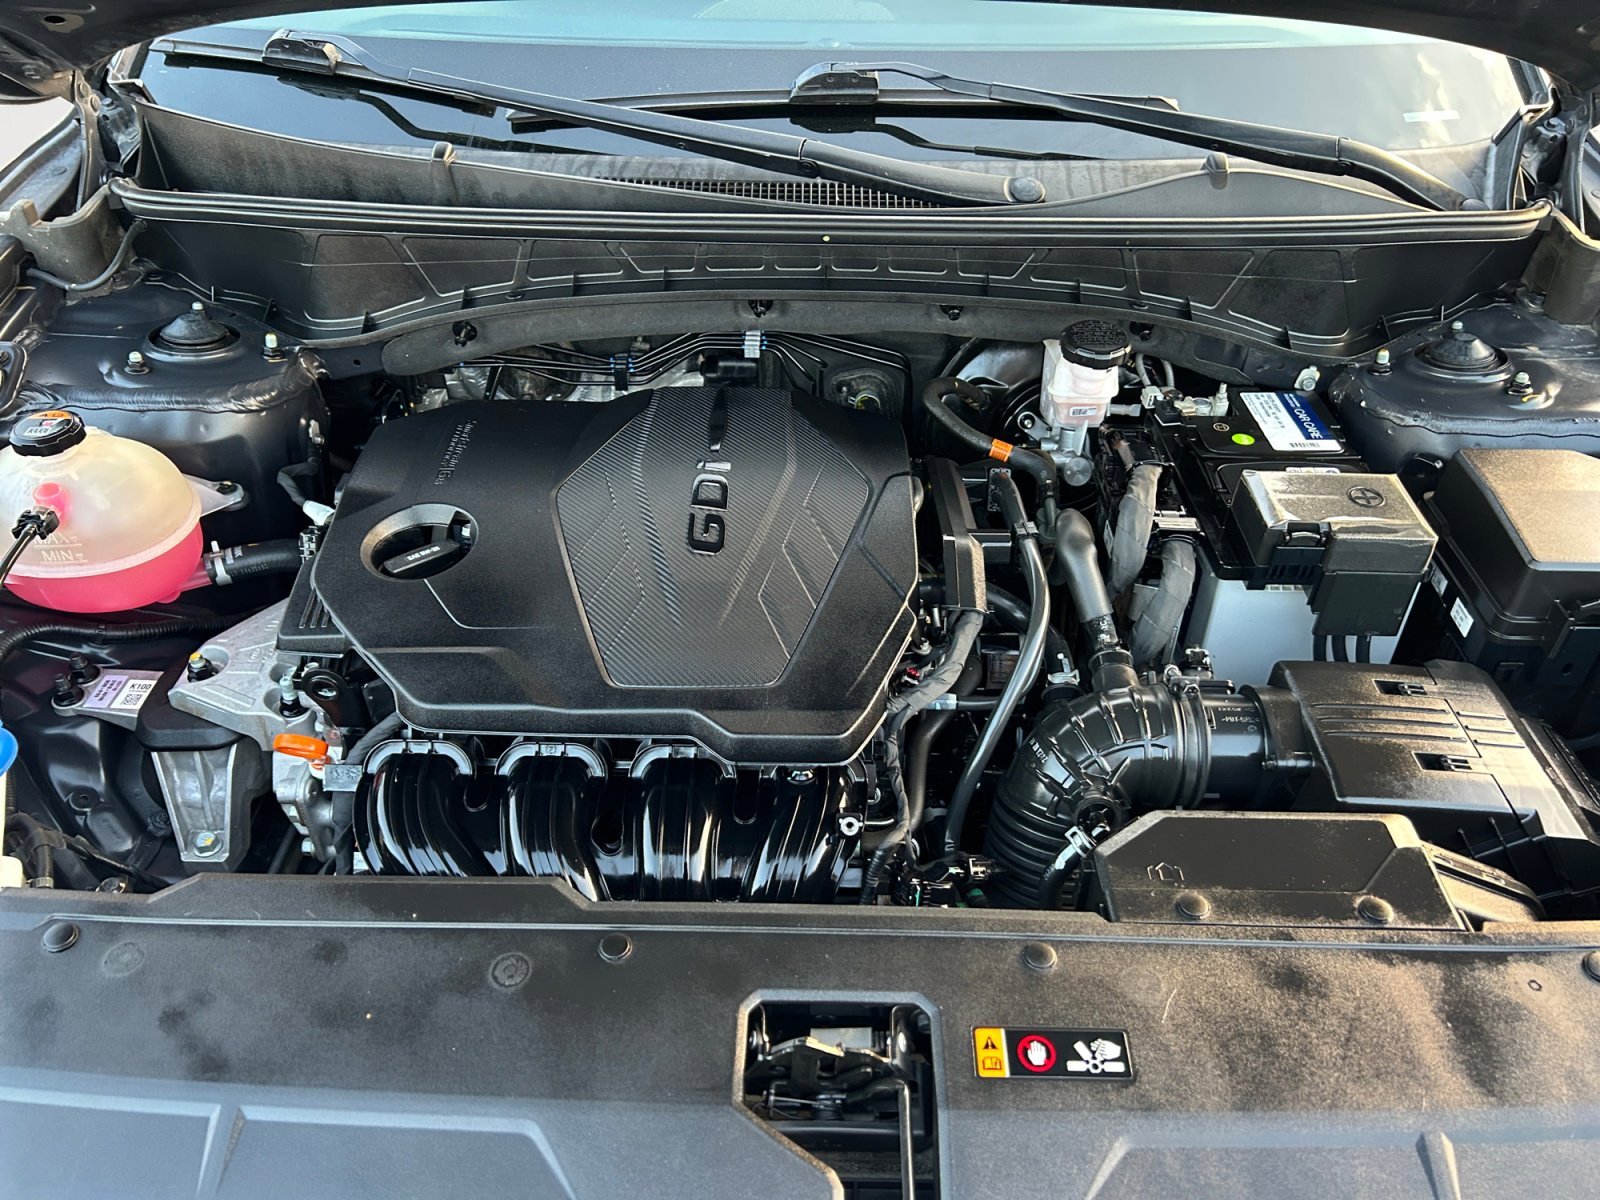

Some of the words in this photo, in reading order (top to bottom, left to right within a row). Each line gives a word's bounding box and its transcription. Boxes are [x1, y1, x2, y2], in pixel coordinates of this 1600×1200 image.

[1294, 408, 1311, 422] CAR
[1303, 421, 1324, 440] CARE
[687, 460, 732, 555] GDi
[41, 550, 74, 561] MIN
